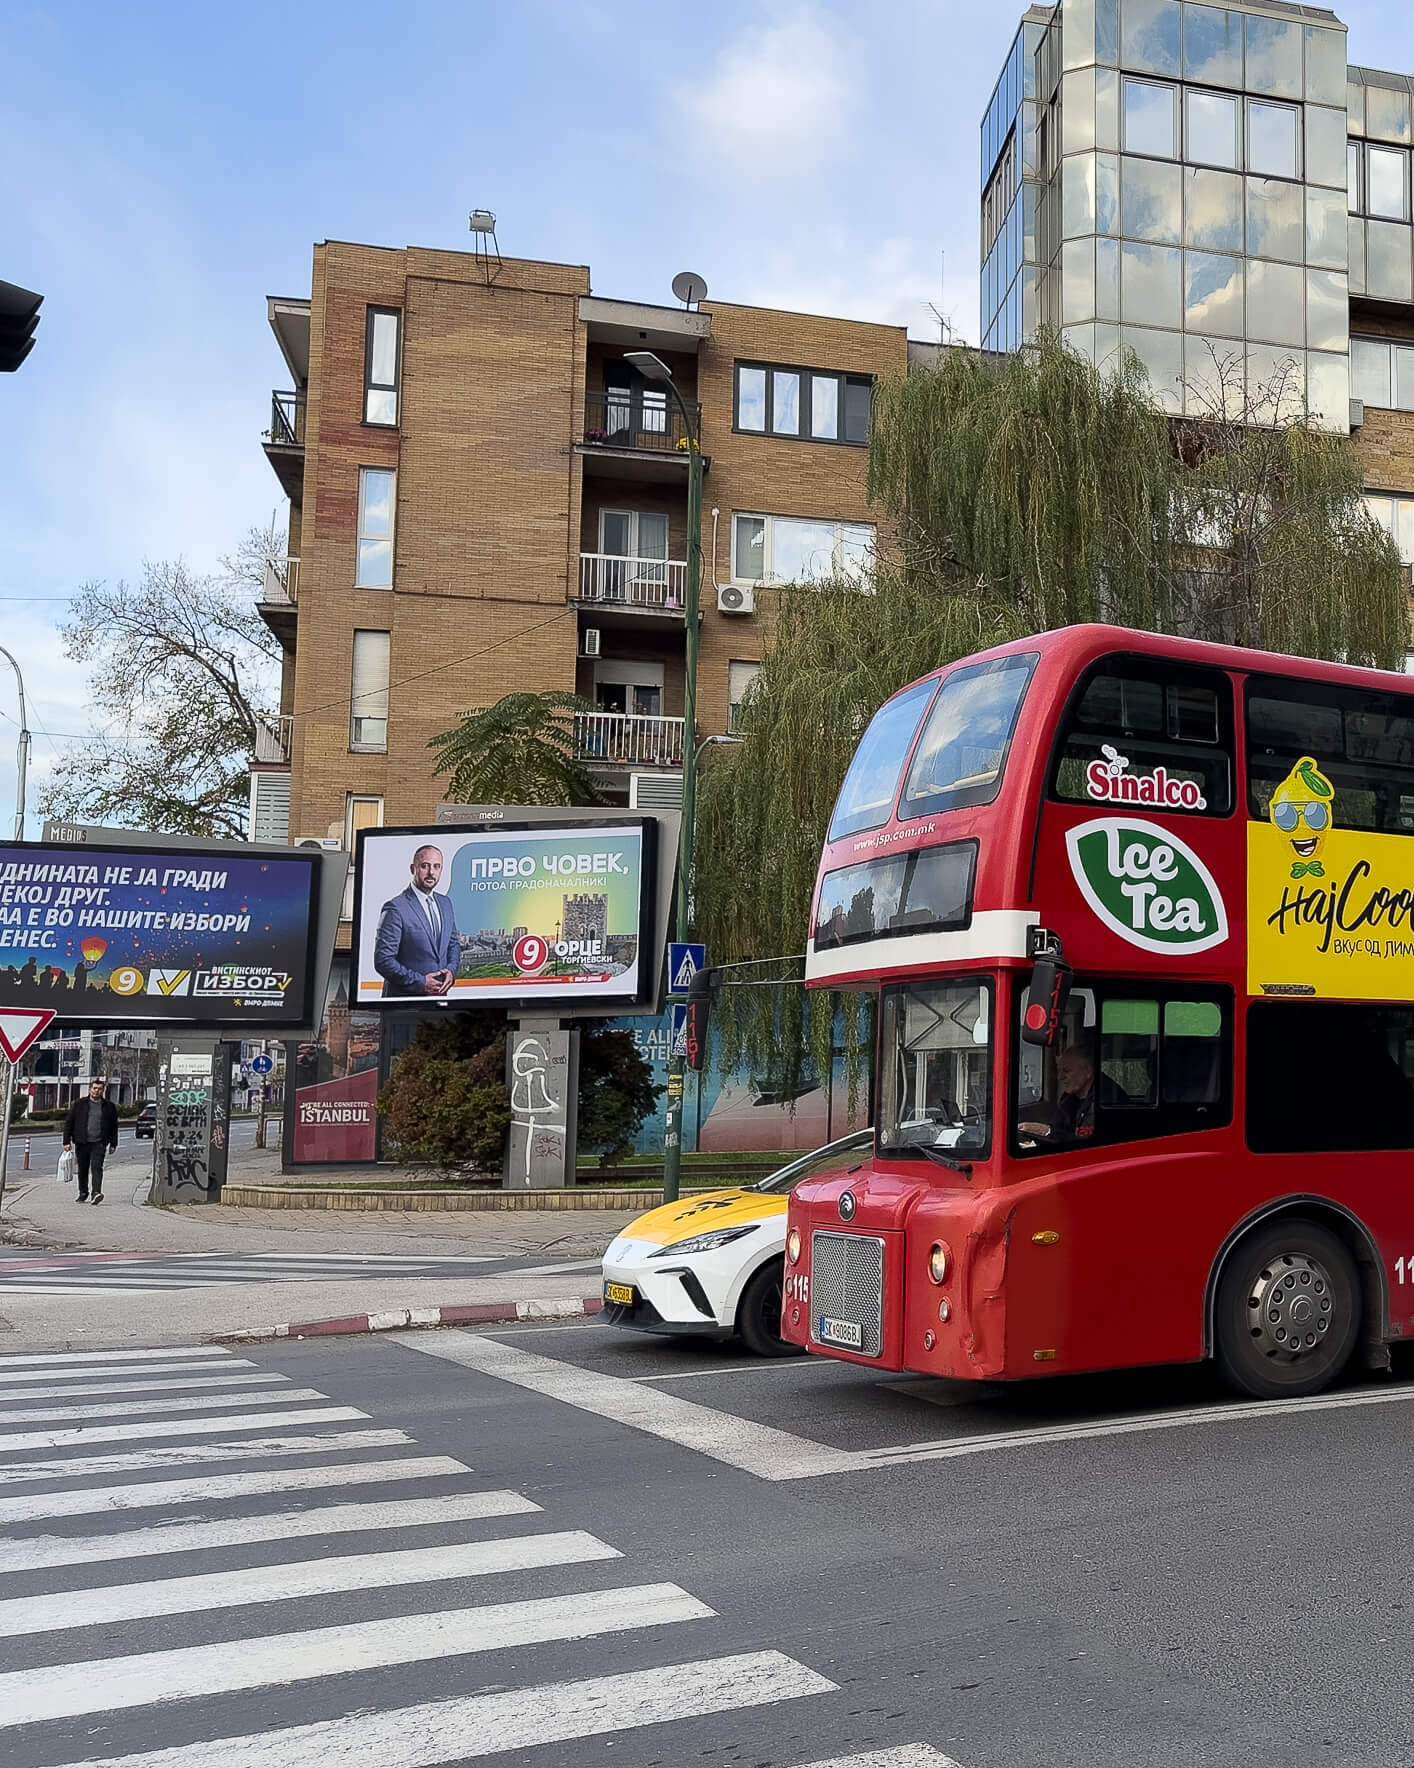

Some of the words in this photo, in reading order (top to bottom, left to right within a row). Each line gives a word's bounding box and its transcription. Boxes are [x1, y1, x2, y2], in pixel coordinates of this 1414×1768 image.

[1088, 762, 1201, 808] Sinalco
[854, 822, 936, 851] www.jsp.com.mk
[471, 856, 536, 878] ПРВО
[543, 853, 629, 875] ЧОВЕК,
[1104, 828, 1178, 880] Ice
[104, 867, 133, 886] НЕ
[134, 869, 157, 886] ЈА
[162, 870, 228, 891] ГРАДИ
[471, 880, 507, 891] ПОТОА
[0, 885, 53, 904] ЕКОЈ
[54, 887, 111, 908] ДРУГ.
[1120, 881, 1206, 932] Tea
[27, 908, 41, 926] Е
[45, 908, 74, 927] ВО
[78, 910, 165, 930] НАШИТЕ
[169, 913, 251, 933] ИЗБОРИ
[521, 939, 540, 966] 9
[555, 940, 601, 957] ОРЦЕ
[1364, 939, 1381, 957] од
[117, 971, 137, 992] 9
[203, 975, 277, 989] ИЗБОР
